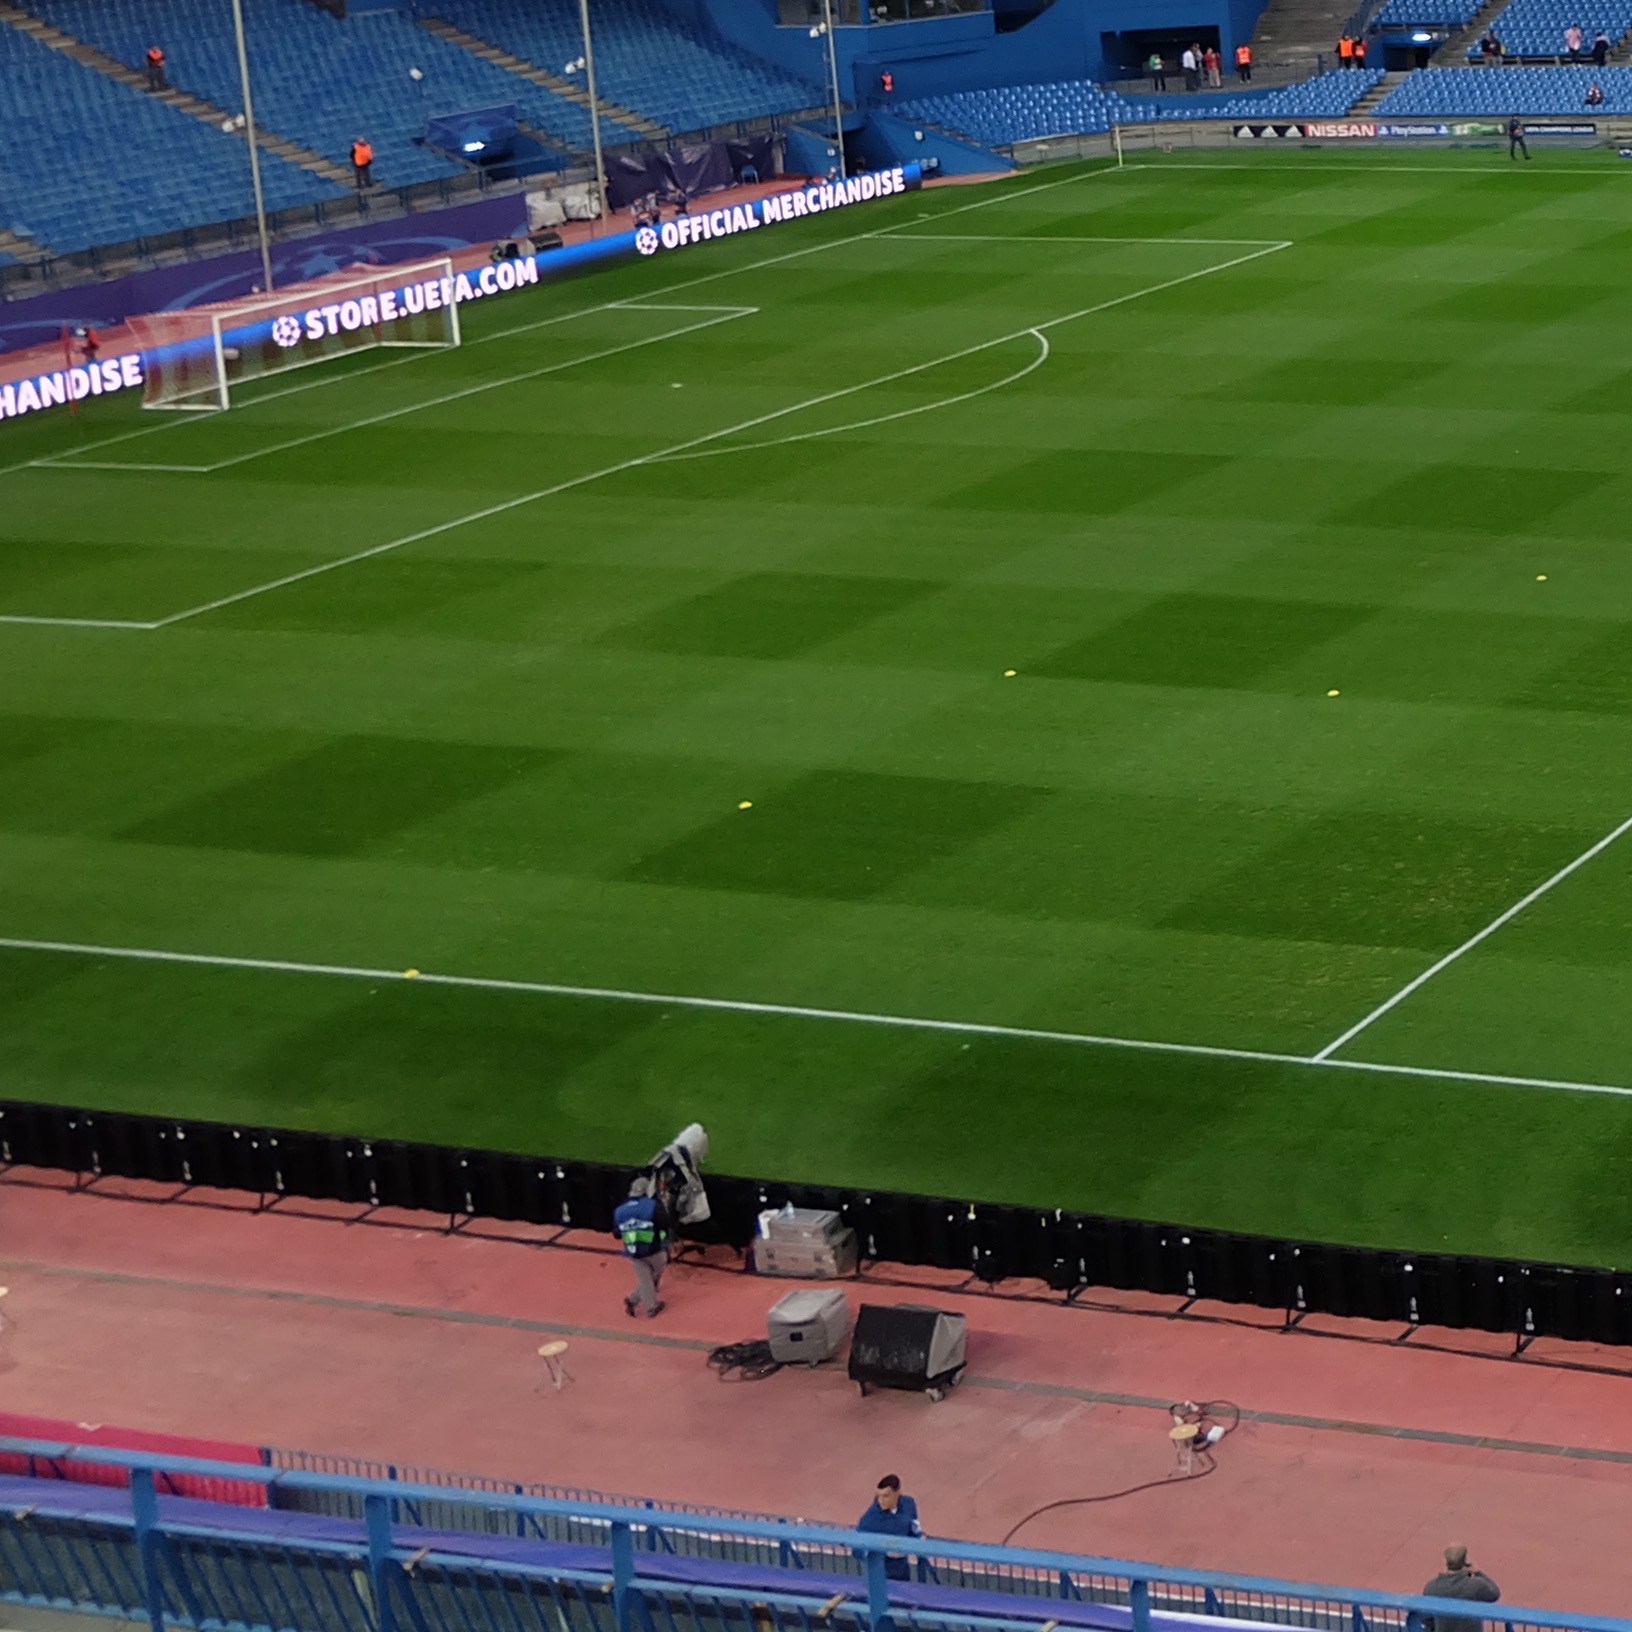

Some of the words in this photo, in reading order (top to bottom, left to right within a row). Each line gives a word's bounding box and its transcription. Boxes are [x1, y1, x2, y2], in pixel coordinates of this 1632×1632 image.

[1308, 125, 1375, 137] NISSAN
[661, 204, 760, 249] OFFICIAL
[762, 168, 906, 225] MERCHANDISE
[305, 257, 538, 340] STORE.UEFA.COM
